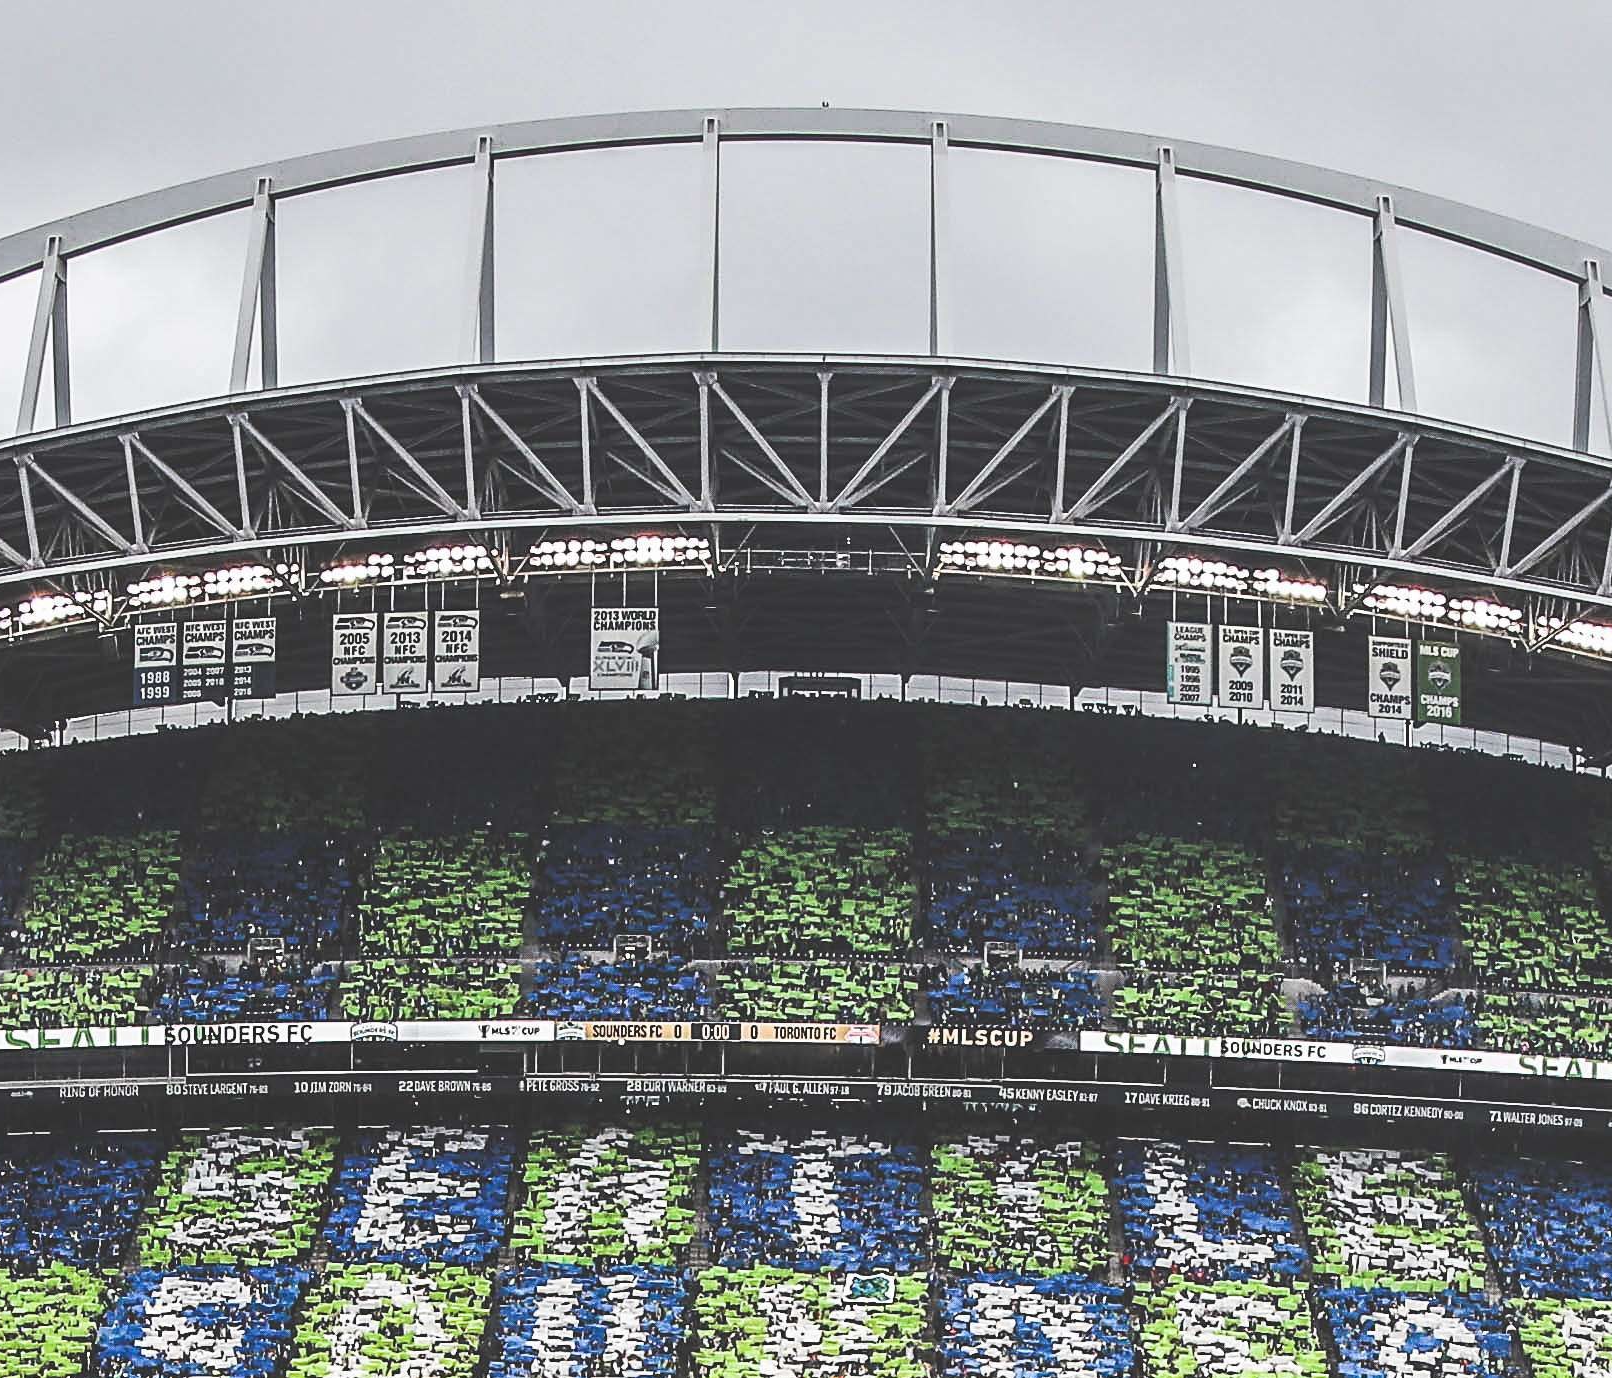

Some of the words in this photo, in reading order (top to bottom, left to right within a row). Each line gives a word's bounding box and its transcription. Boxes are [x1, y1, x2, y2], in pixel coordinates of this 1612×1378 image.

[594, 611, 619, 620] 2013
[622, 611, 656, 620] WORLD
[153, 625, 175, 634] WEST
[202, 623, 225, 632] WEST
[252, 620, 275, 629] WEST
[594, 621, 656, 631] CHAMPIONS
[1175, 626, 1204, 634] LEAGUE
[136, 634, 175, 646] CHAMPS
[185, 632, 225, 643] CHAMPS
[234, 629, 275, 641] CHAMPS
[339, 633, 370, 645] 2005
[390, 632, 421, 644] 2013
[441, 631, 472, 643] 2014
[1174, 634, 1206, 642] CHAMPS
[1223, 635, 1260, 645] CHAMPS
[394, 644, 416, 655] NFC
[445, 643, 468, 654] NFC
[1273, 638, 1310, 649] CHAMPS
[343, 645, 366, 656] NFC
[1372, 647, 1408, 659] SHIELD
[1419, 644, 1439, 657] MLS
[1440, 646, 1459, 658] CUP
[140, 671, 170, 685] 1988
[1229, 680, 1253, 691] 2009
[1280, 684, 1303, 694] 2011
[140, 687, 170, 699] 1999
[1179, 693, 1200, 702] 2007
[1229, 692, 1253, 702] 2010
[1370, 693, 1411, 705] CHAMPS
[1280, 695, 1303, 705] 2014
[1420, 694, 1459, 707] CHAMPS
[1379, 704, 1401, 714] 2014
[1427, 705, 1452, 718] 2016
[165, 1024, 279, 1045] SOUNDERS
[287, 1024, 312, 1044] FC
[491, 1026, 511, 1036] MLS
[522, 1026, 540, 1037] CUP
[593, 1024, 646, 1039] SOUNDERS
[649, 1024, 663, 1039] FC
[701, 1025, 730, 1040] 0:00
[773, 1026, 822, 1040] TORONTO
[824, 1026, 836, 1040] FC
[927, 1027, 1034, 1047] #MLSCUP
[1221, 1040, 1304, 1059] SOUNDERS
[1308, 1044, 1326, 1058] FC
[60, 1086, 85, 1098] RING
[87, 1086, 101, 1098] OF
[103, 1085, 139, 1097] HONOR
[166, 1084, 181, 1095] 80
[183, 1083, 208, 1095] STEVE
[210, 1083, 247, 1094] LARGENT
[294, 1082, 308, 1093] 10
[329, 1081, 352, 1092] ZORN
[398, 1081, 414, 1093] 22
[415, 1081, 437, 1093] DAVE
[439, 1081, 470, 1092] BROWN
[526, 1081, 548, 1092] PETE
[550, 1080, 579, 1092] GROSS
[627, 1081, 642, 1092] 28
[643, 1081, 666, 1092] CURT
[668, 1081, 705, 1093] WARNER
[803, 1083, 829, 1094] ALLEN
[877, 1084, 891, 1096] 79
[893, 1084, 920, 1096] JACOB
[922, 1085, 951, 1097] GREEN
[999, 1087, 1015, 1099] 45
[1016, 1088, 1044, 1100] KENNY
[1046, 1089, 1079, 1101] EASLEY
[1125, 1092, 1137, 1103] 17
[1139, 1092, 1161, 1104] DAVE
[1162, 1093, 1189, 1106] KRIEG
[1252, 1097, 1281, 1111] CHUCK
[1284, 1098, 1308, 1112] KNOX
[1353, 1103, 1368, 1114] 96
[1370, 1104, 1401, 1116] CORTEZ
[1404, 1105, 1443, 1119] KENNEDY
[1489, 1110, 1502, 1122] 71
[1503, 1111, 1535, 1124] WALTER
[1537, 1113, 1564, 1126] JONES
